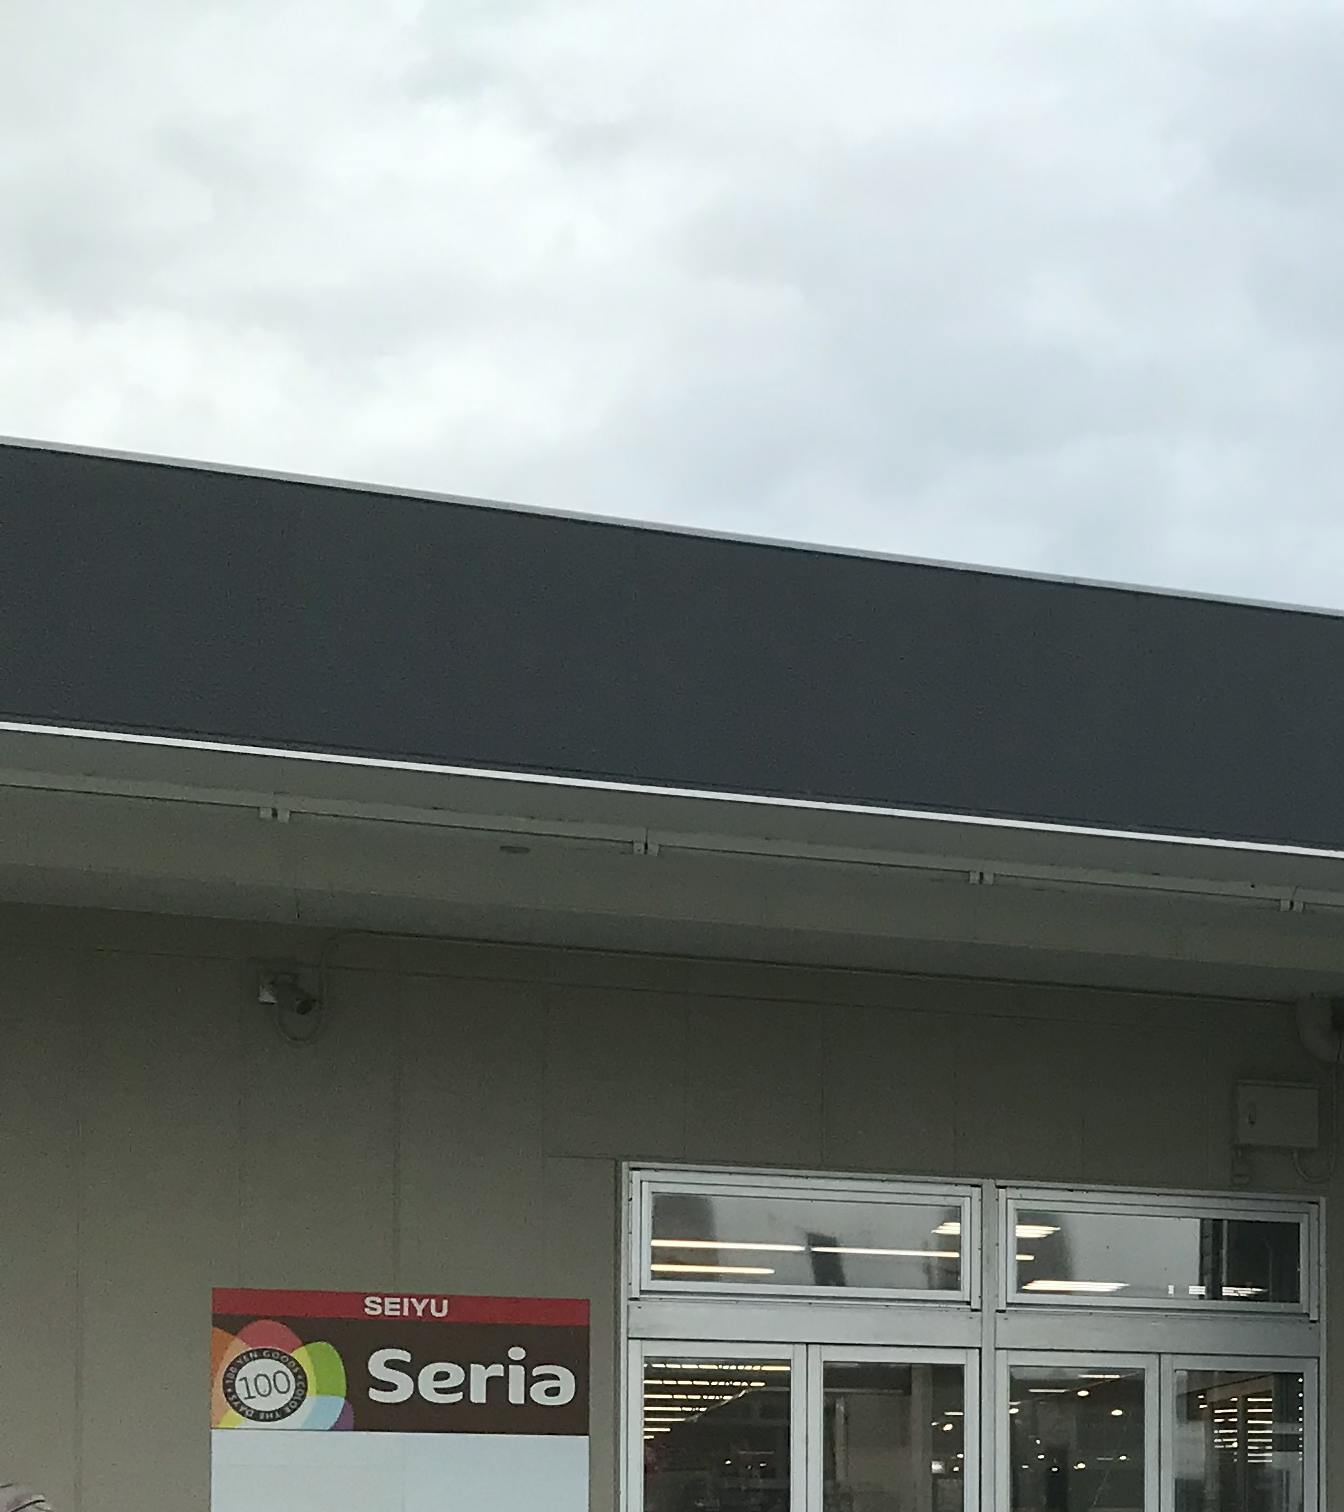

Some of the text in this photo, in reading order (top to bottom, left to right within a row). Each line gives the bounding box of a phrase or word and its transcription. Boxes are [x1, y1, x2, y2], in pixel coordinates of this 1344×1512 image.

[363, 1295, 449, 1318] SEIYU
[238, 1369, 291, 1400] 100
[366, 1345, 577, 1407] Seria
